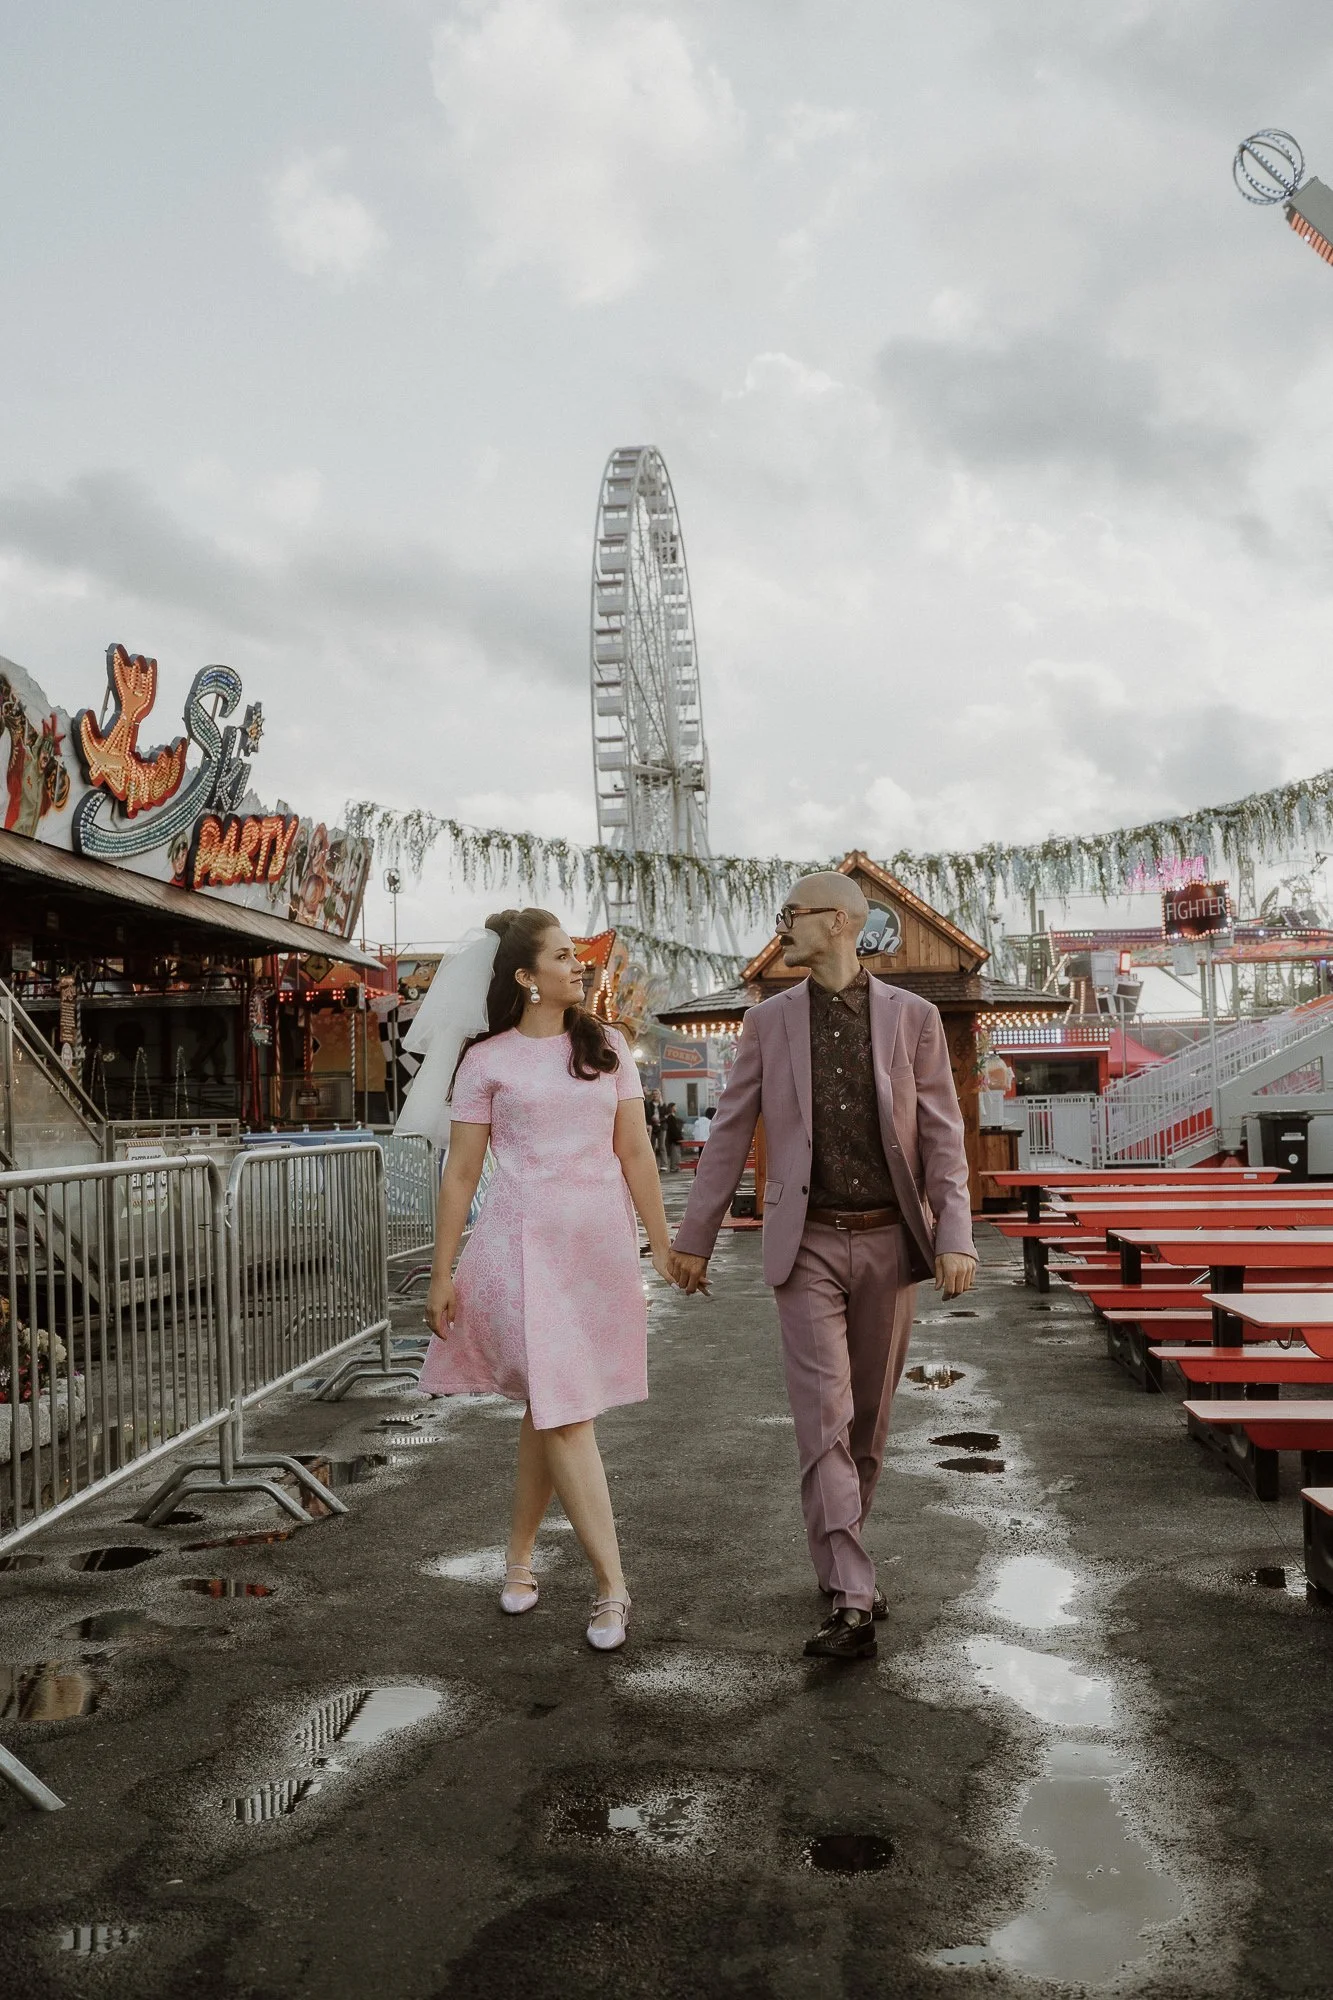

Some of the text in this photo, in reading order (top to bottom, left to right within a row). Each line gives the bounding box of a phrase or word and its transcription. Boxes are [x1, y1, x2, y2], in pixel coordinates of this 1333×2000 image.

[193, 815, 299, 887] PARTY
[1166, 897, 1226, 921] FIGHTER
[666, 1048, 696, 1061] TOKEN
